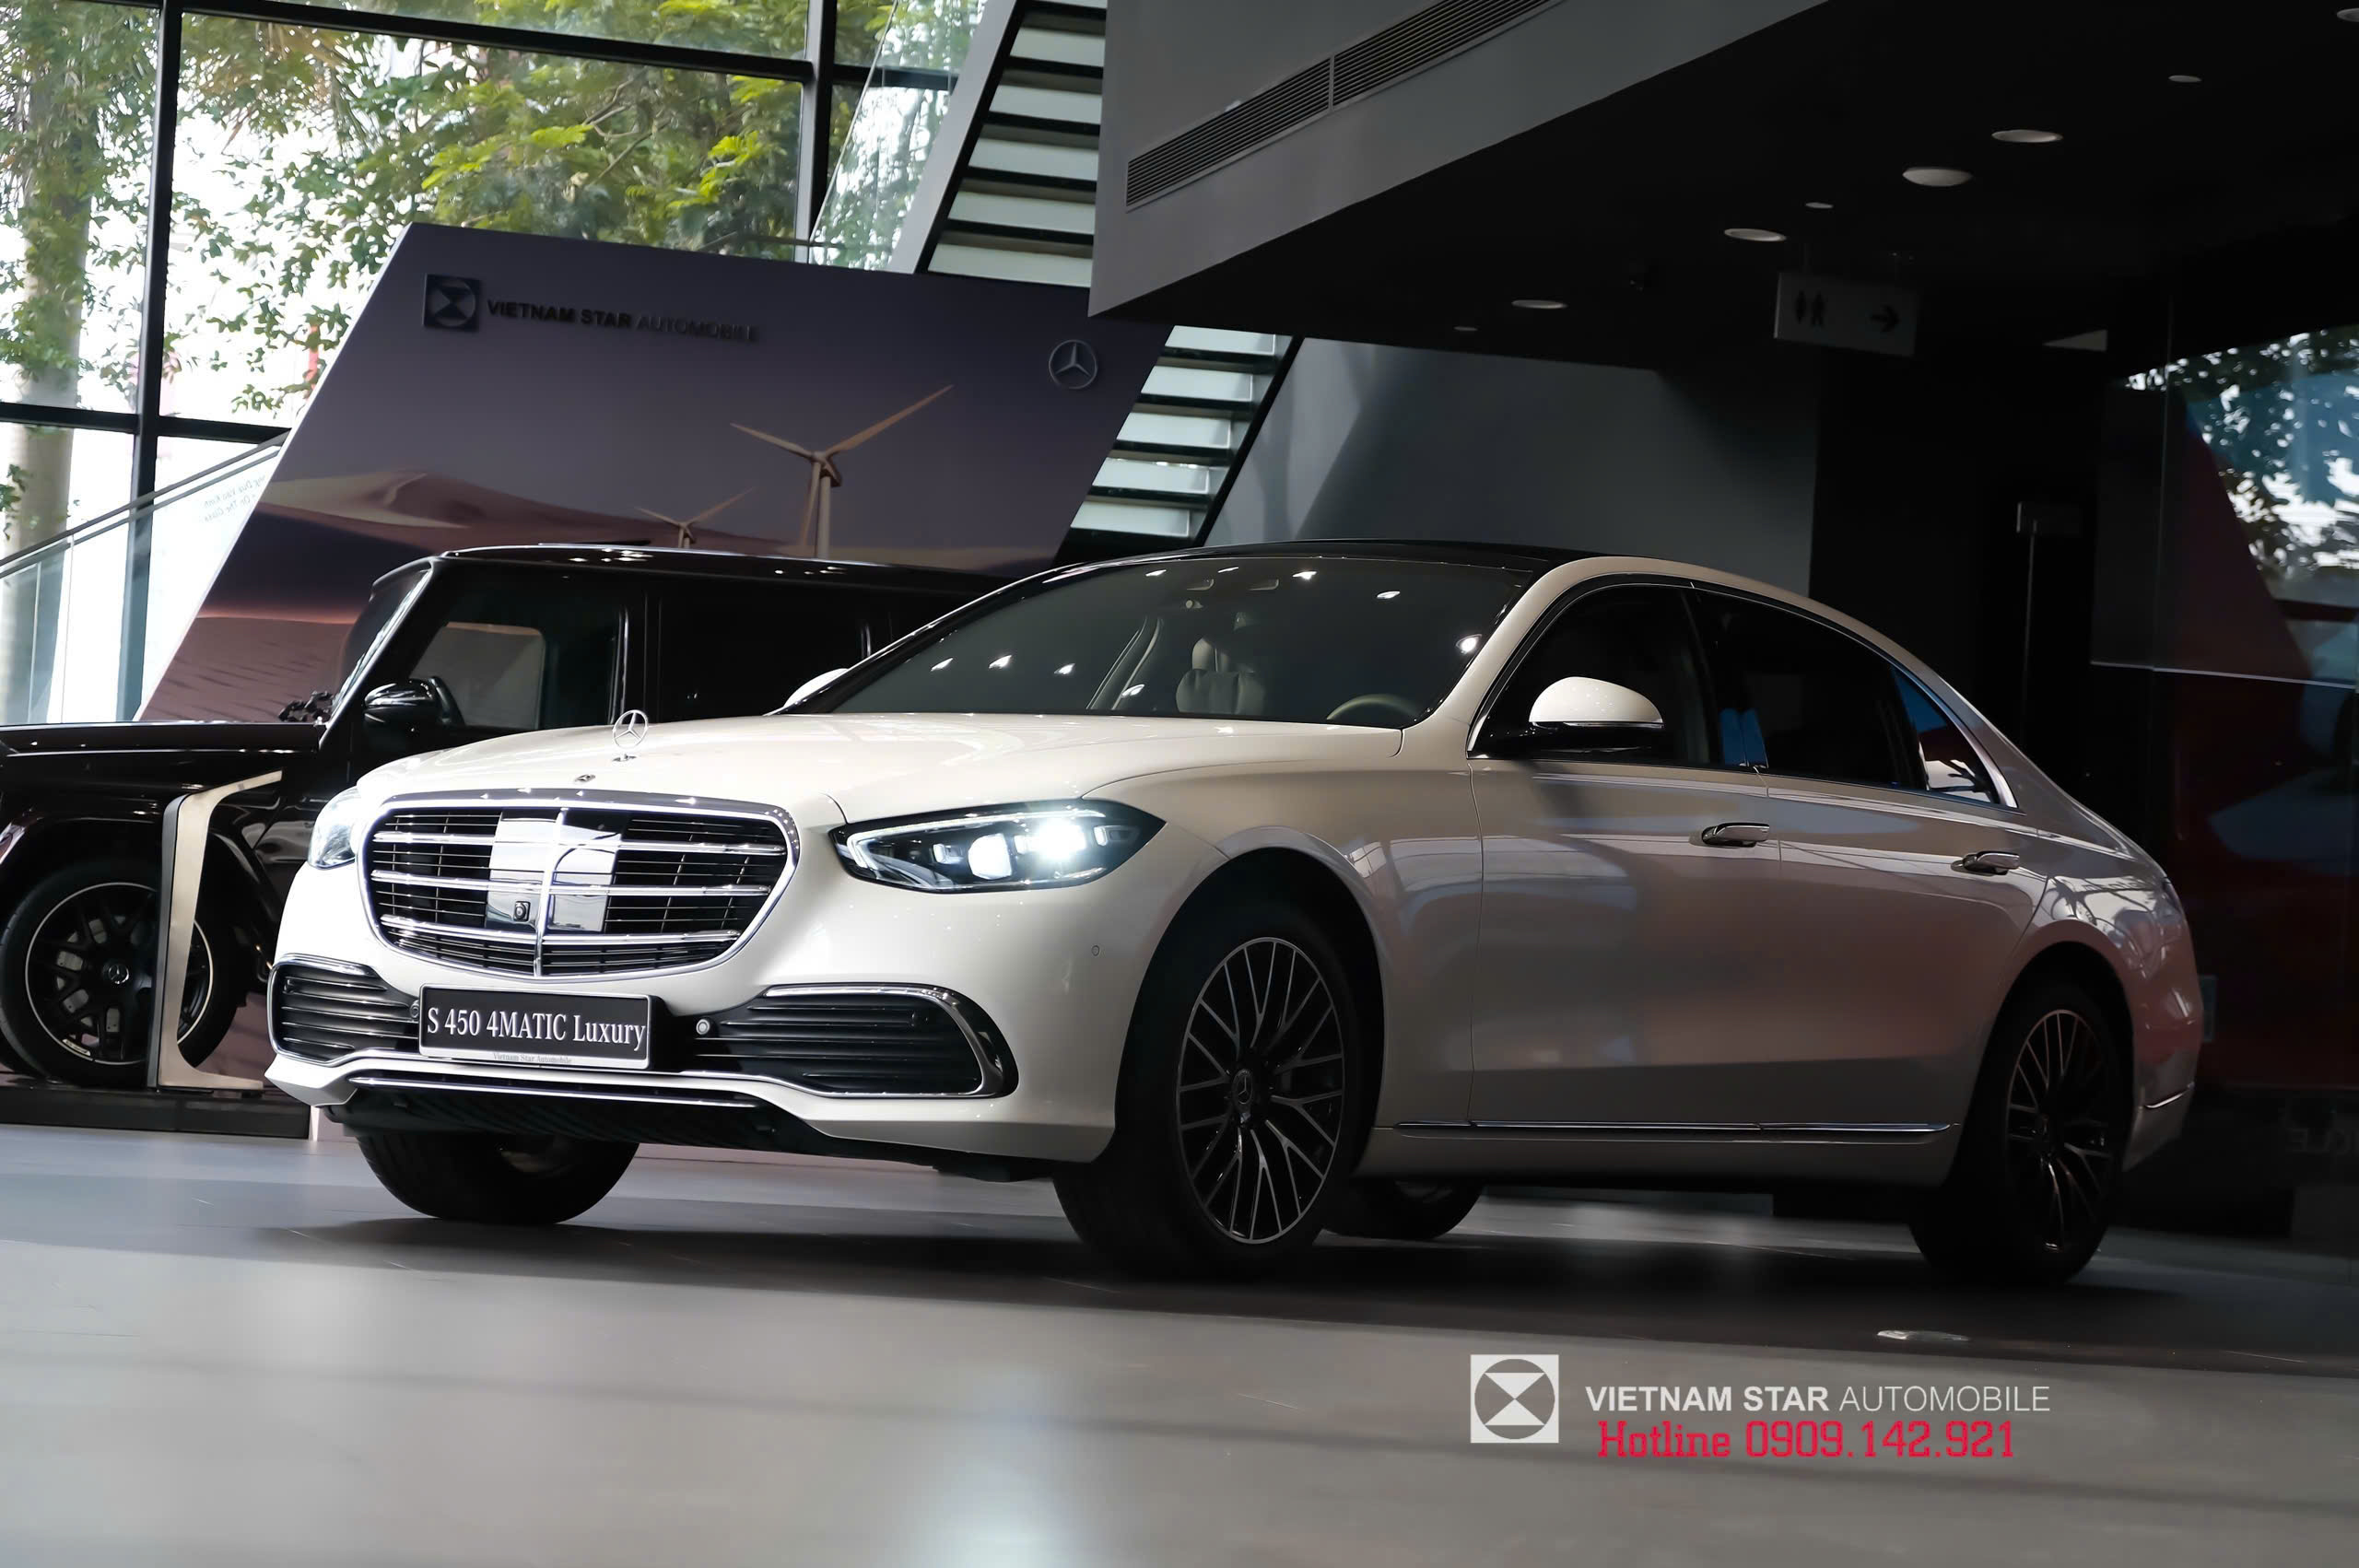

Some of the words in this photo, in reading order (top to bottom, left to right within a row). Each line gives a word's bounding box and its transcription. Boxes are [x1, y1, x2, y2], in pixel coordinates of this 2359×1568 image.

[487, 299, 576, 322] VIETNAM
[581, 309, 632, 329] STAR
[634, 315, 758, 343] AUTOMOBILE
[428, 1007, 440, 1034] S
[444, 1008, 480, 1036] 450
[486, 1011, 567, 1041] 4MATIC
[572, 1014, 647, 1051] Luxury
[493, 1052, 519, 1062] Vietnam
[521, 1054, 534, 1062] Star
[537, 1055, 571, 1064] Automobile
